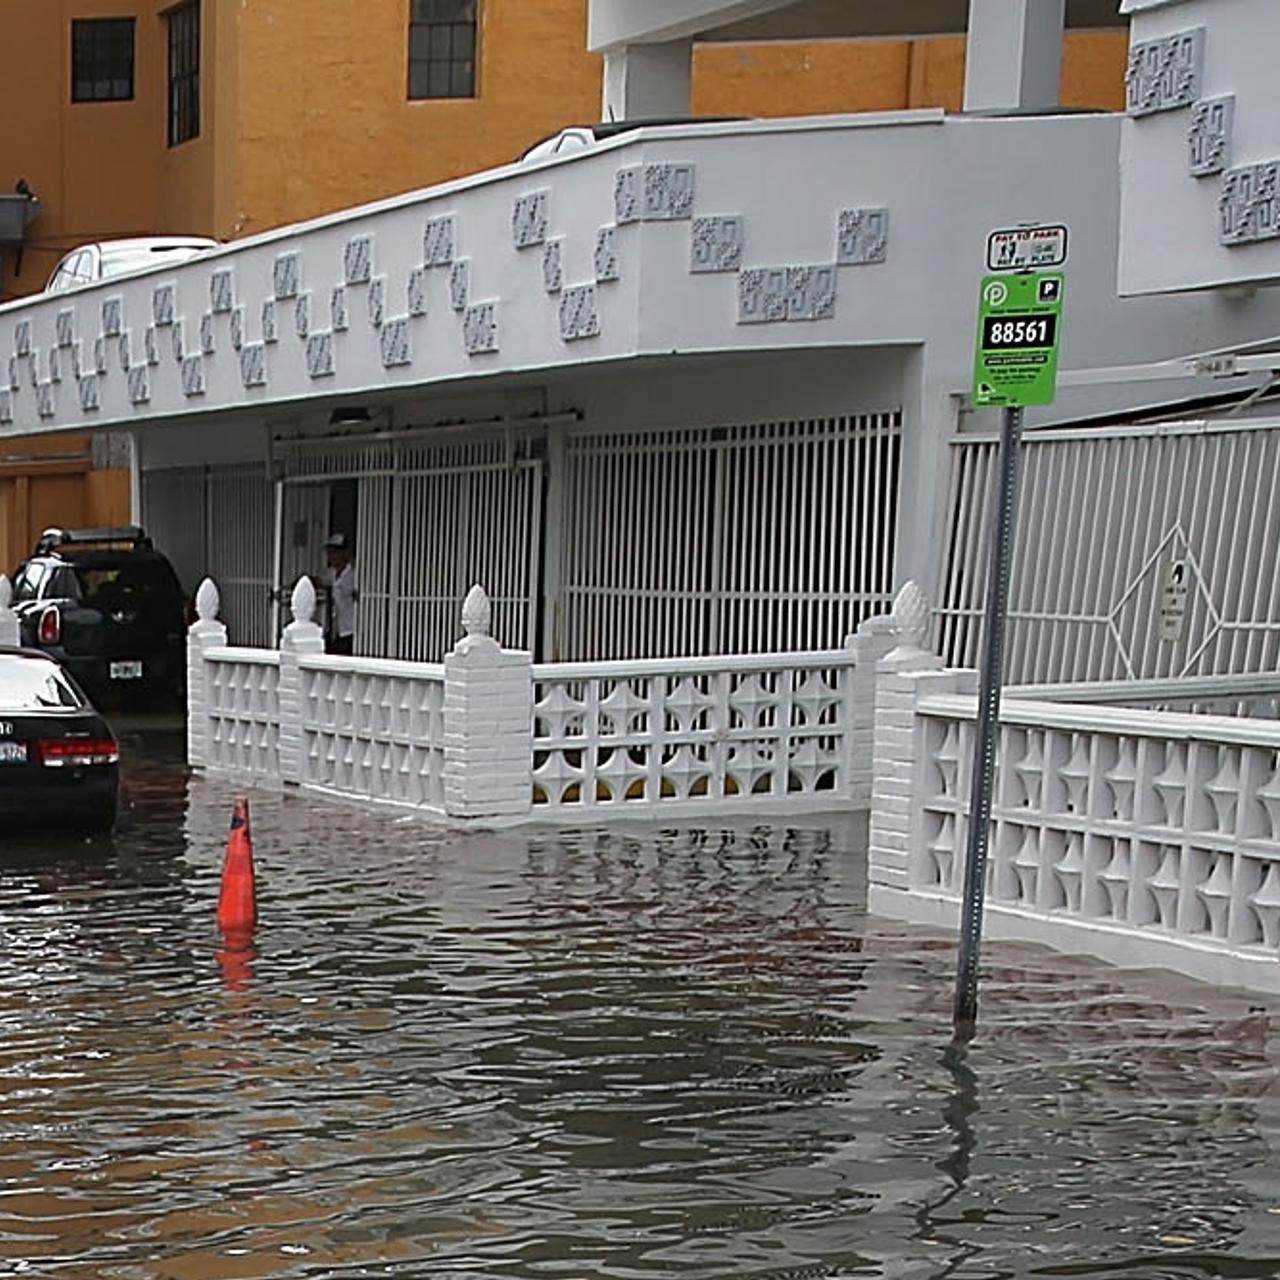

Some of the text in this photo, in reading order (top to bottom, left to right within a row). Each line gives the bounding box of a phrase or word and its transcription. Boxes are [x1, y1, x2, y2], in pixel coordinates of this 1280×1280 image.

[995, 230, 1059, 243] PAY TO PARK
[1043, 281, 1054, 295] P
[991, 320, 1047, 344] 88561
